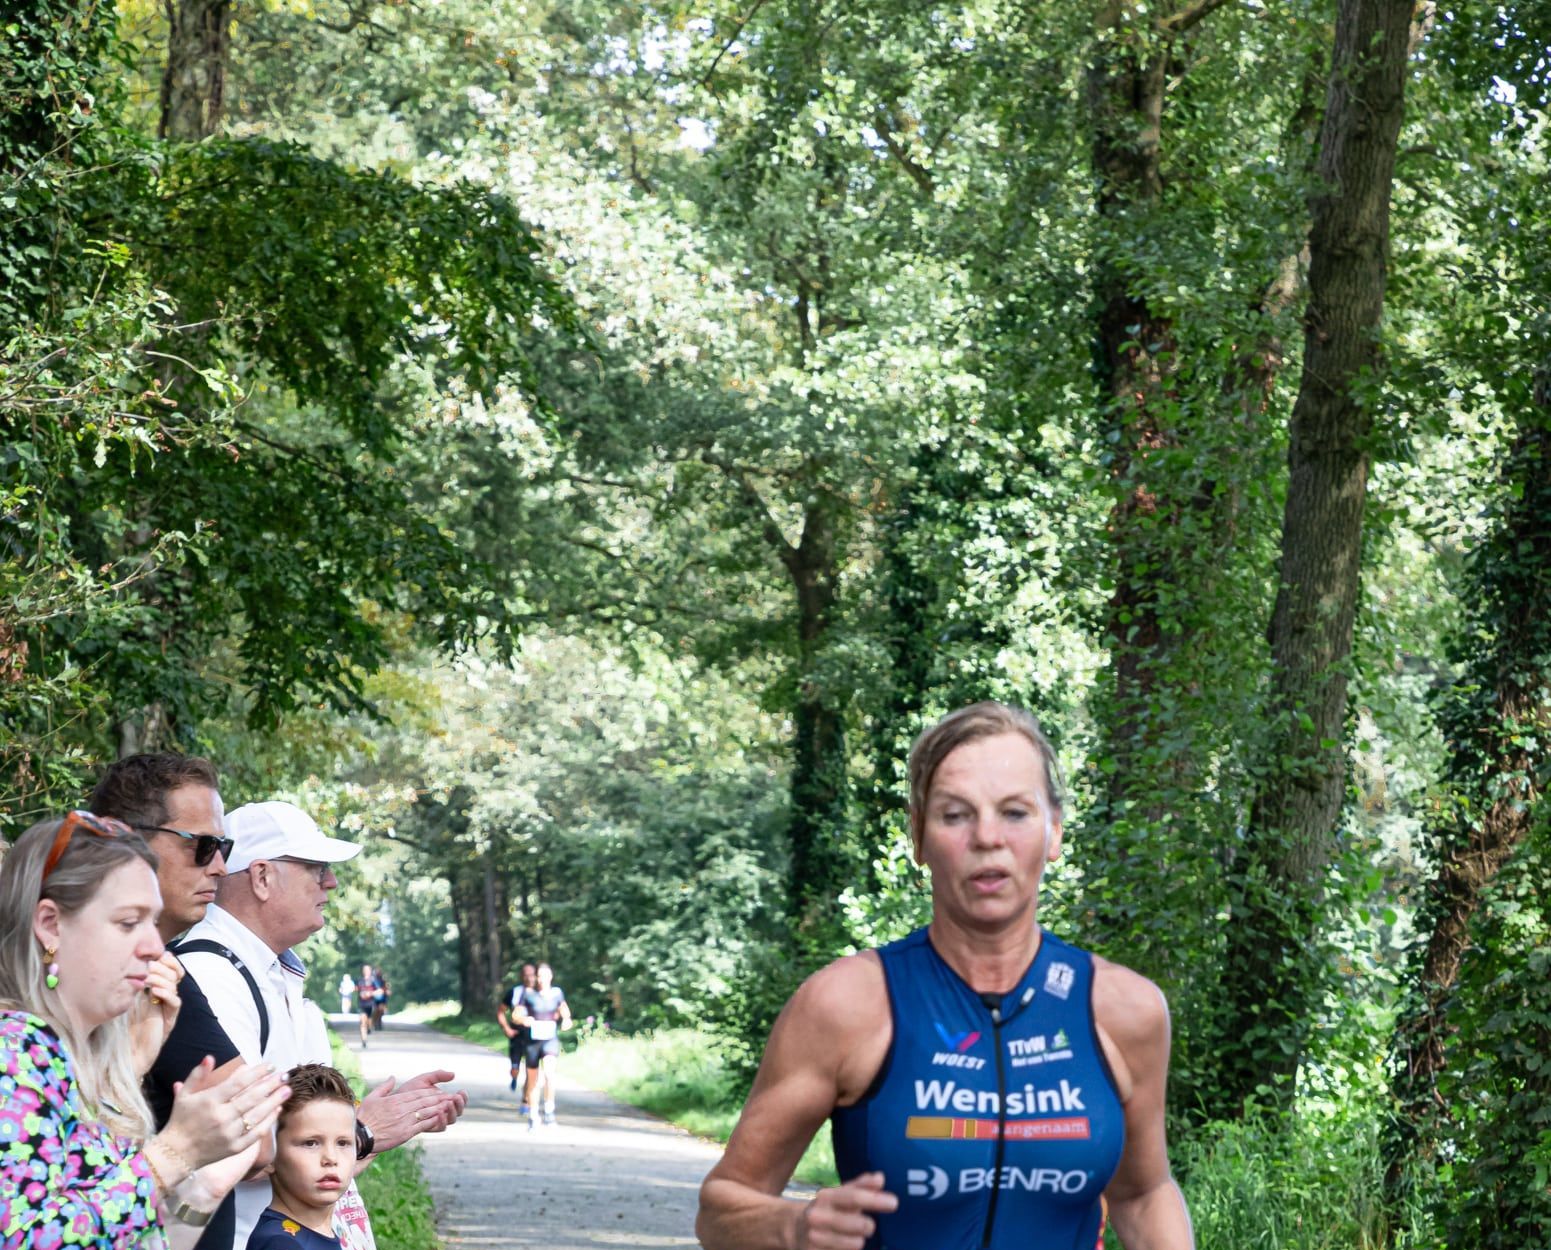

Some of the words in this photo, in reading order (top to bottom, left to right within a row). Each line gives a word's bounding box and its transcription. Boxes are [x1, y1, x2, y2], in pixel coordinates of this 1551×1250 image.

[932, 1051, 987, 1070] WOEST
[914, 1079, 1086, 1115] Wensink
[958, 1165, 1089, 1194] BENRO
